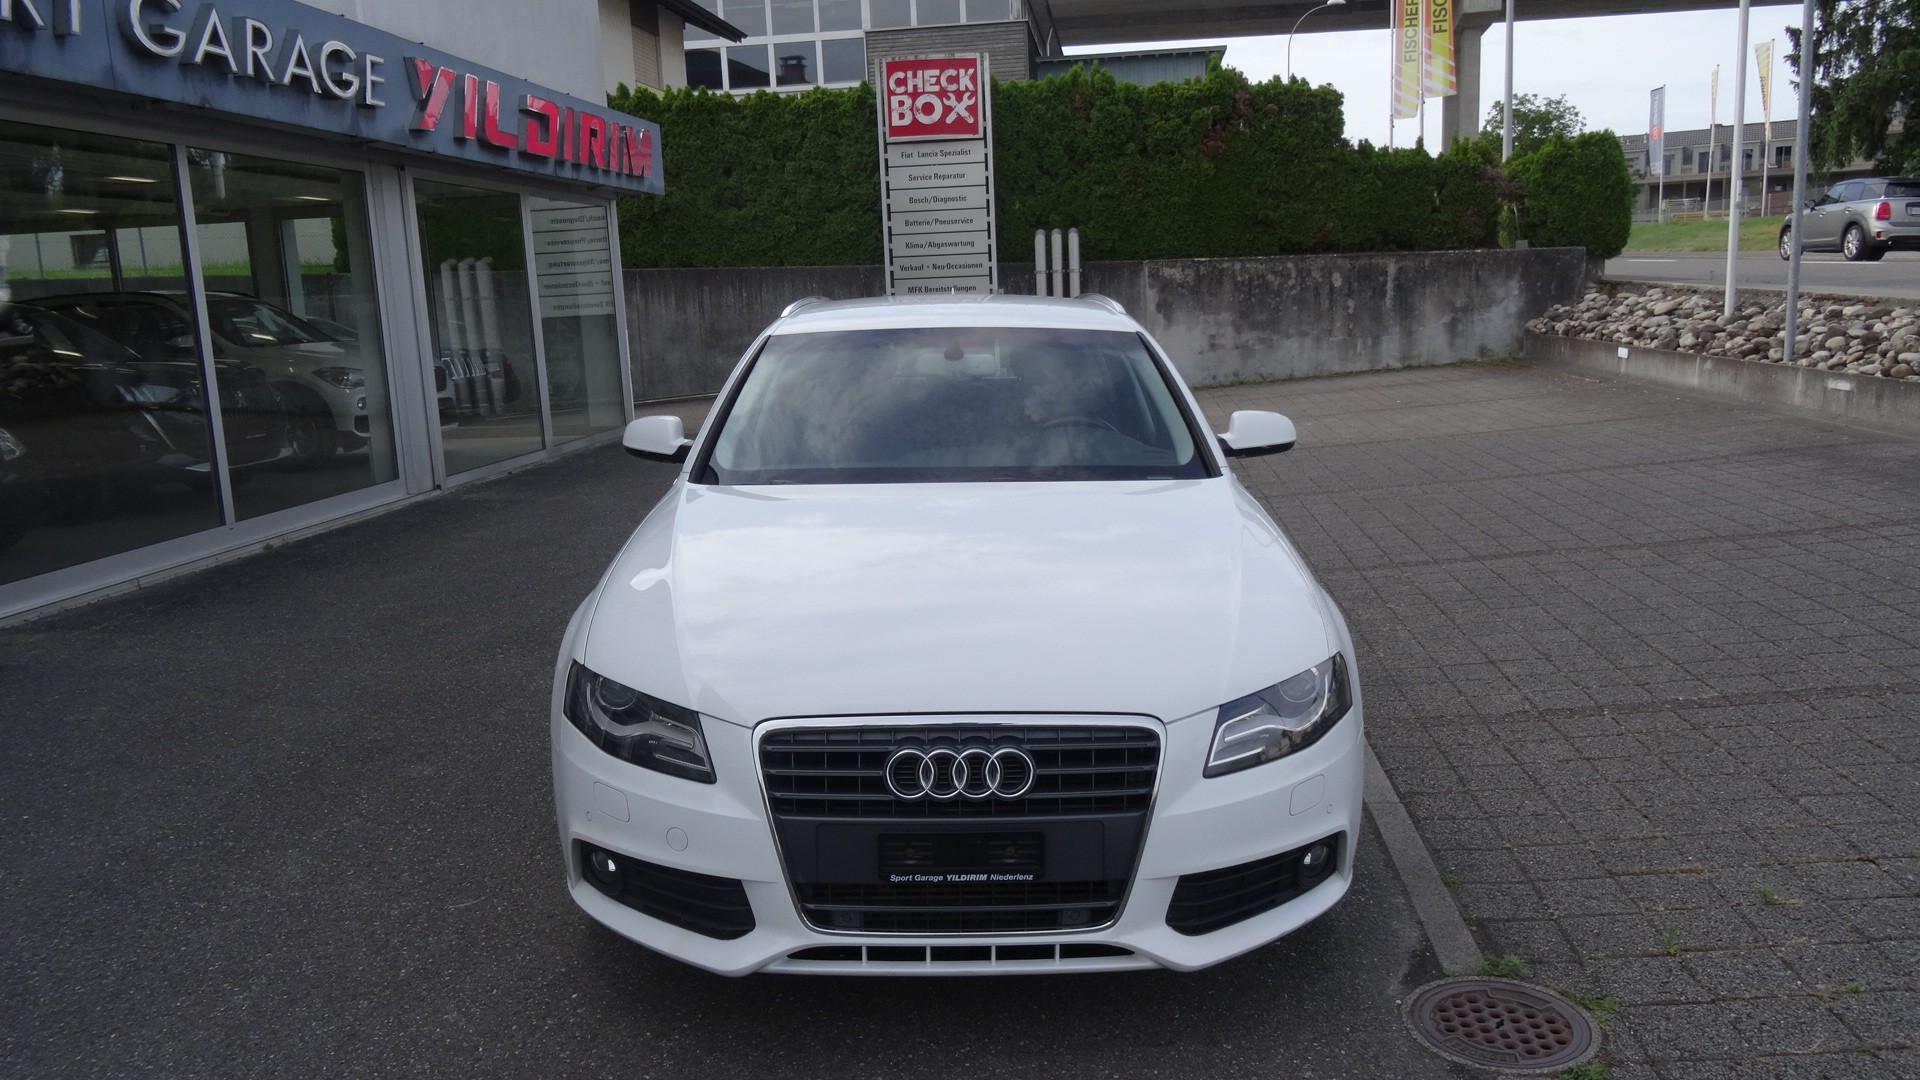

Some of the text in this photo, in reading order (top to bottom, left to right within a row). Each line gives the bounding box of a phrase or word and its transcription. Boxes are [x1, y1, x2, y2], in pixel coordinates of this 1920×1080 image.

[888, 68, 976, 94] CHECK
[121, 0, 653, 178] GARAGE YILDIRIM
[890, 92, 976, 127] BOX
[901, 147, 971, 159] Fiat Lancia Spezialist
[908, 172, 966, 182] Service Reparatur
[908, 194, 967, 205] Bosch/Diagnostic
[904, 217, 974, 227] Batterie/Pneuservice
[905, 239, 975, 250] Klima/Abgaswartung
[899, 261, 983, 272] Verkauf Neu-Occasionen
[907, 286, 923, 294] MFK
[889, 872, 1034, 883] Sport Garage YILDIRIM Niederlenz
